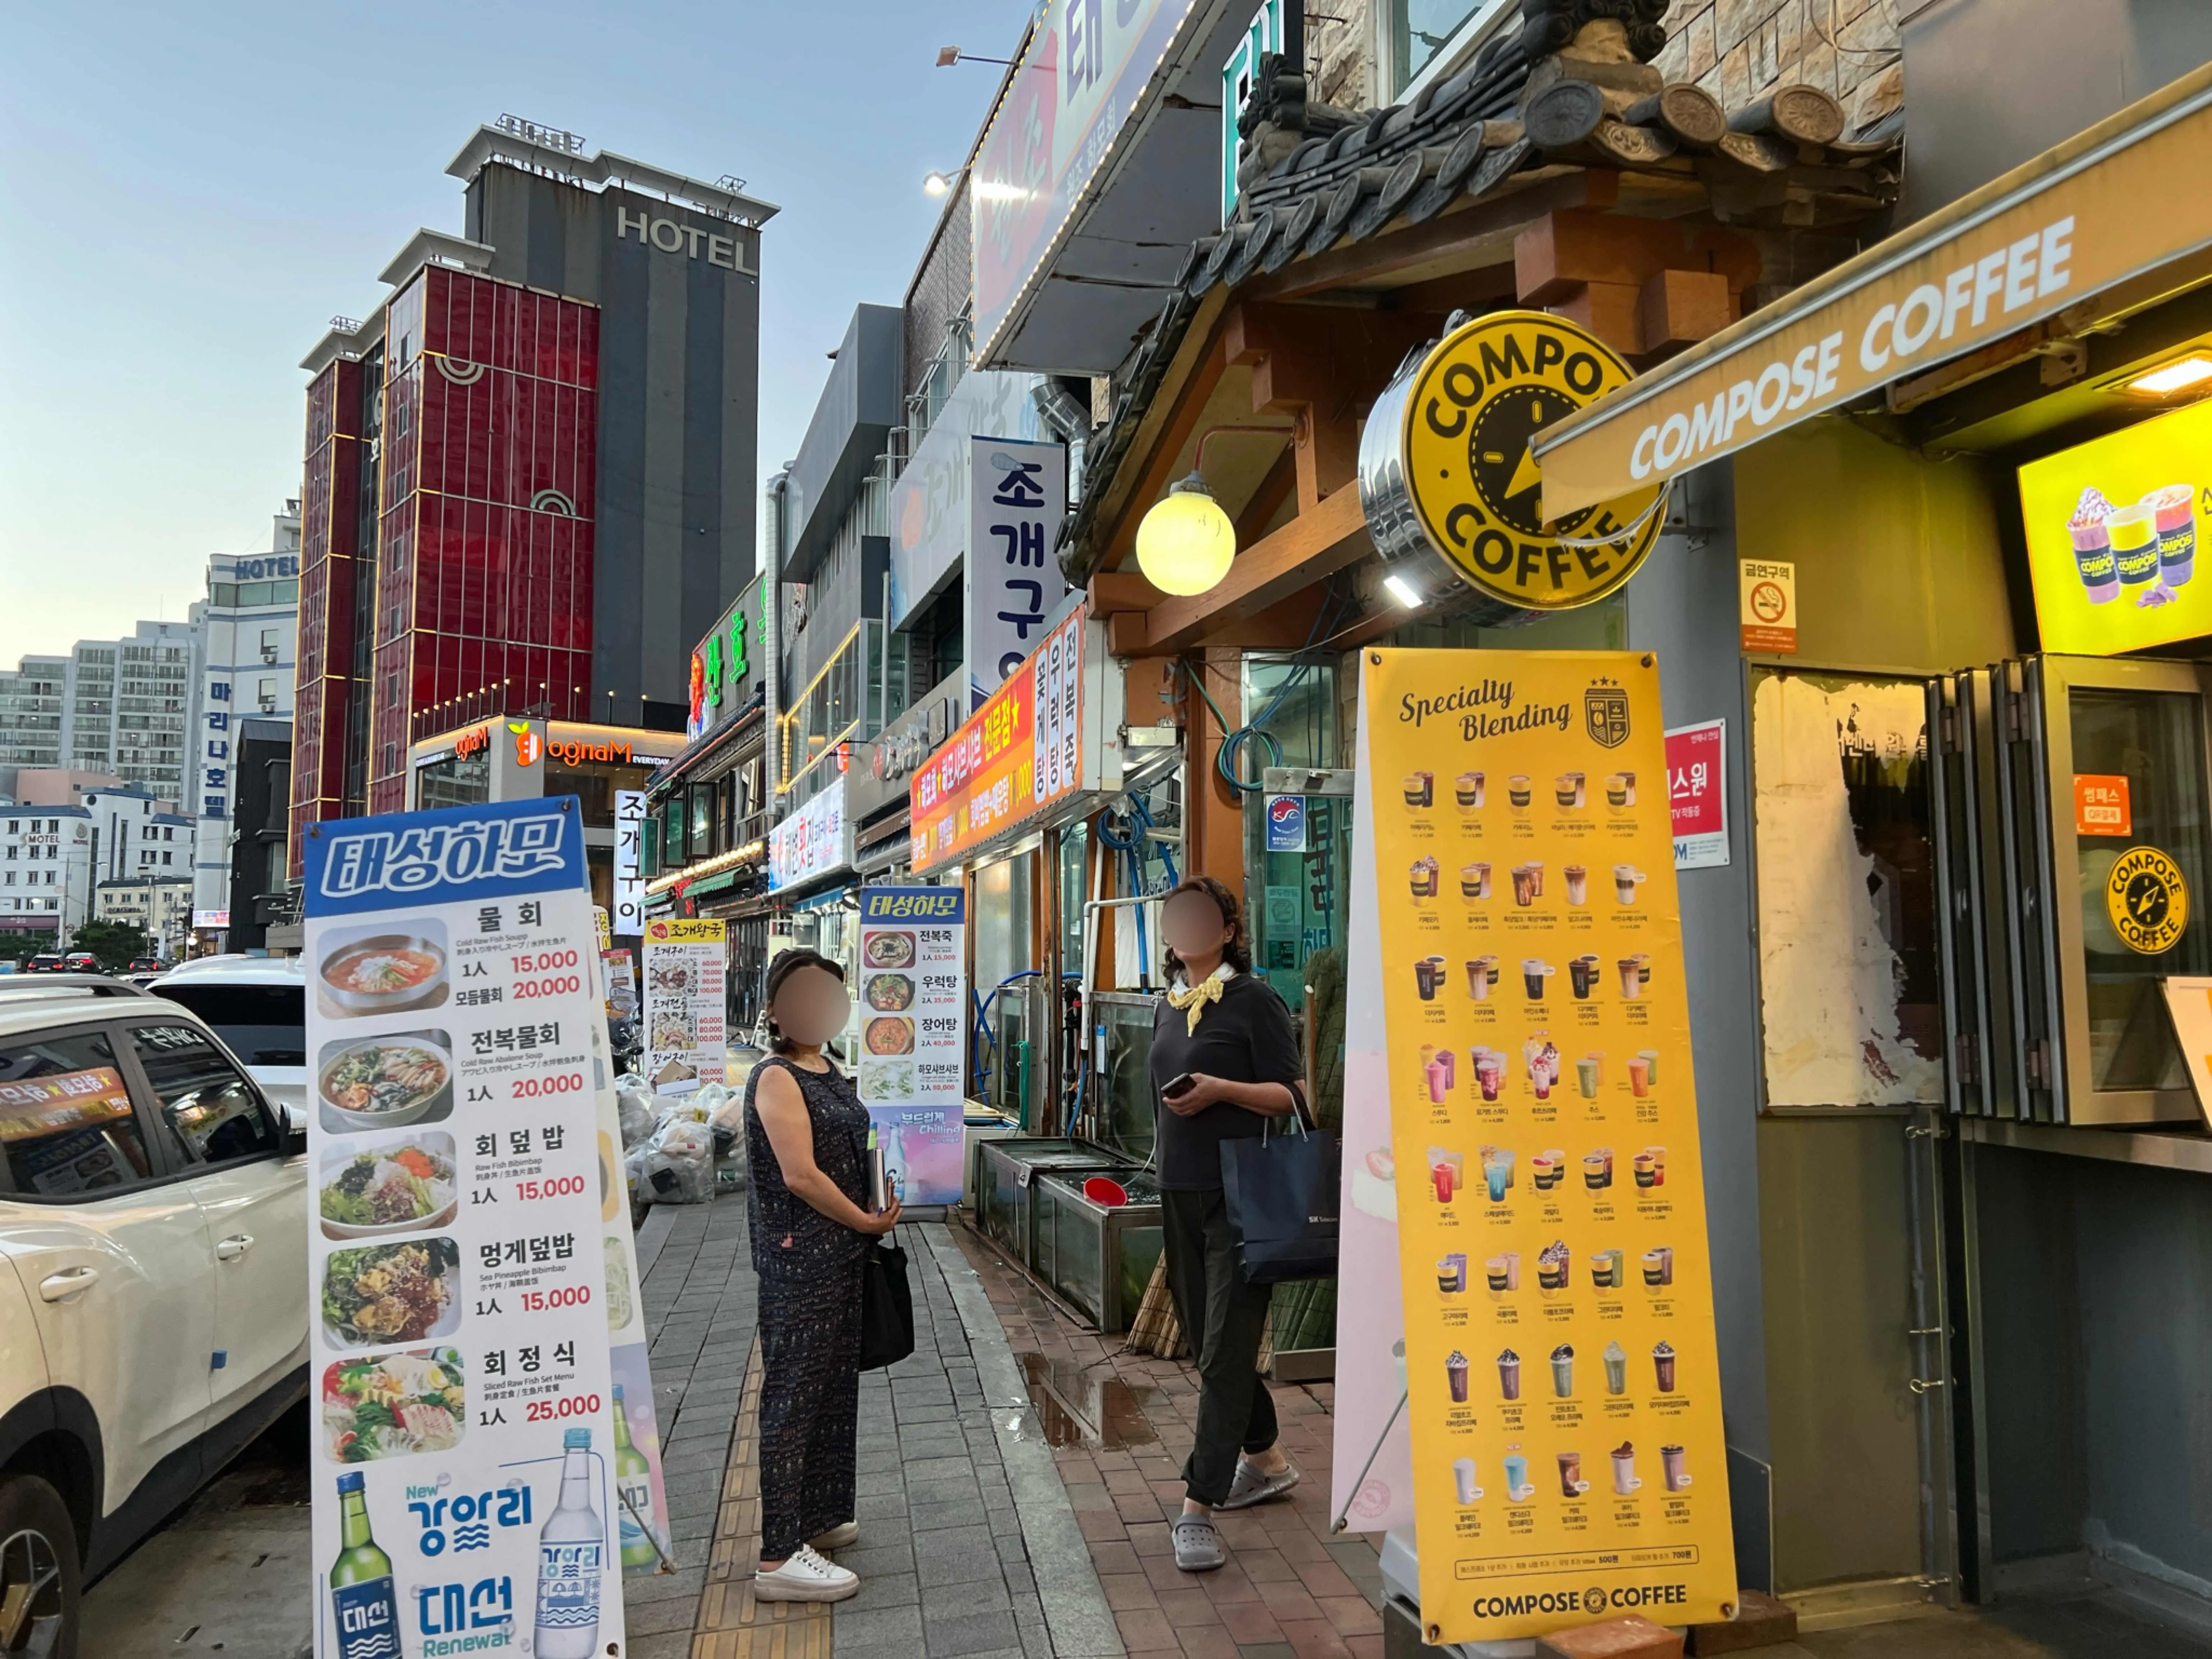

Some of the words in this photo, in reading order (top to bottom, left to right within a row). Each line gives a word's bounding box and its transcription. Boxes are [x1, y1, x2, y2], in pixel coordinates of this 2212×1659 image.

[1087, 96, 1116, 166] 하모회
[618, 206, 757, 277] HOTEL
[1630, 331, 1842, 480] COMPOSE
[1860, 216, 2074, 372] COFFEE
[1426, 333, 1619, 439] COMPO
[1446, 503, 1636, 589] COFFEE
[235, 556, 299, 579] HOTEL
[1745, 563, 1789, 580] 금연구역
[2081, 556, 2113, 572] COMPO
[1051, 645, 1060, 785] 우럭탕
[1065, 631, 1075, 782] 전복죽
[1400, 679, 1515, 727] Specialty
[1459, 703, 1572, 741] Blending
[205, 682, 231, 817] 마리나호텔
[942, 725, 981, 795] 하모샤브샤브
[984, 694, 1010, 761] 전문점
[633, 756, 669, 765] EVERYDAY
[2084, 787, 2120, 803] 썸패스
[320, 814, 566, 898] 태성하모
[618, 796, 644, 927] 조개구이
[2112, 854, 2182, 896] COMPOSE
[868, 895, 957, 917] 태성하모
[670, 923, 722, 938] 조개왕국
[920, 931, 952, 942] 전복죽
[2119, 916, 2180, 947] COFFEE
[463, 961, 488, 977] 1人
[511, 950, 578, 973] 15,000
[653, 946, 687, 957] 조개구이
[456, 987, 502, 1006] 모듬물회
[513, 975, 580, 999] 20,000
[922, 975, 958, 988] 우럭탕
[471, 1022, 559, 1054] 전복물회
[922, 1018, 958, 1031] 장어탕
[495, 1055, 524, 1064] Abalone
[525, 1052, 544, 1061] Soup
[918, 1064, 959, 1075] 하모샤브샤브
[467, 1085, 493, 1102] 1人
[512, 1073, 583, 1099] 20,000
[901, 1111, 945, 1126] 부드럽게
[919, 1124, 961, 1136] Chilling
[508, 1157, 543, 1167] Bibimbap
[471, 1187, 498, 1204] 1人
[516, 1175, 585, 1200] 15,000
[480, 1233, 575, 1268] 멍게덮밥
[494, 1269, 530, 1280] Pineapple
[531, 1265, 567, 1274] Bibimbap
[476, 1298, 503, 1315] 1人
[521, 1285, 590, 1312] 15,000
[484, 1381, 506, 1391] Sliced
[525, 1377, 539, 1385] Fish
[480, 1408, 507, 1426] 1人
[526, 1394, 600, 1422] 25,000
[406, 1485, 438, 1500] New
[1599, 1555, 1618, 1564] 500원
[1672, 1550, 1691, 1559] 700원
[419, 1575, 513, 1635] 대선
[1474, 1592, 1579, 1618] COMPOSE
[1611, 1584, 1687, 1608] COFFEE
[343, 1600, 390, 1633] 대선
[423, 1628, 511, 1658] Renewal
